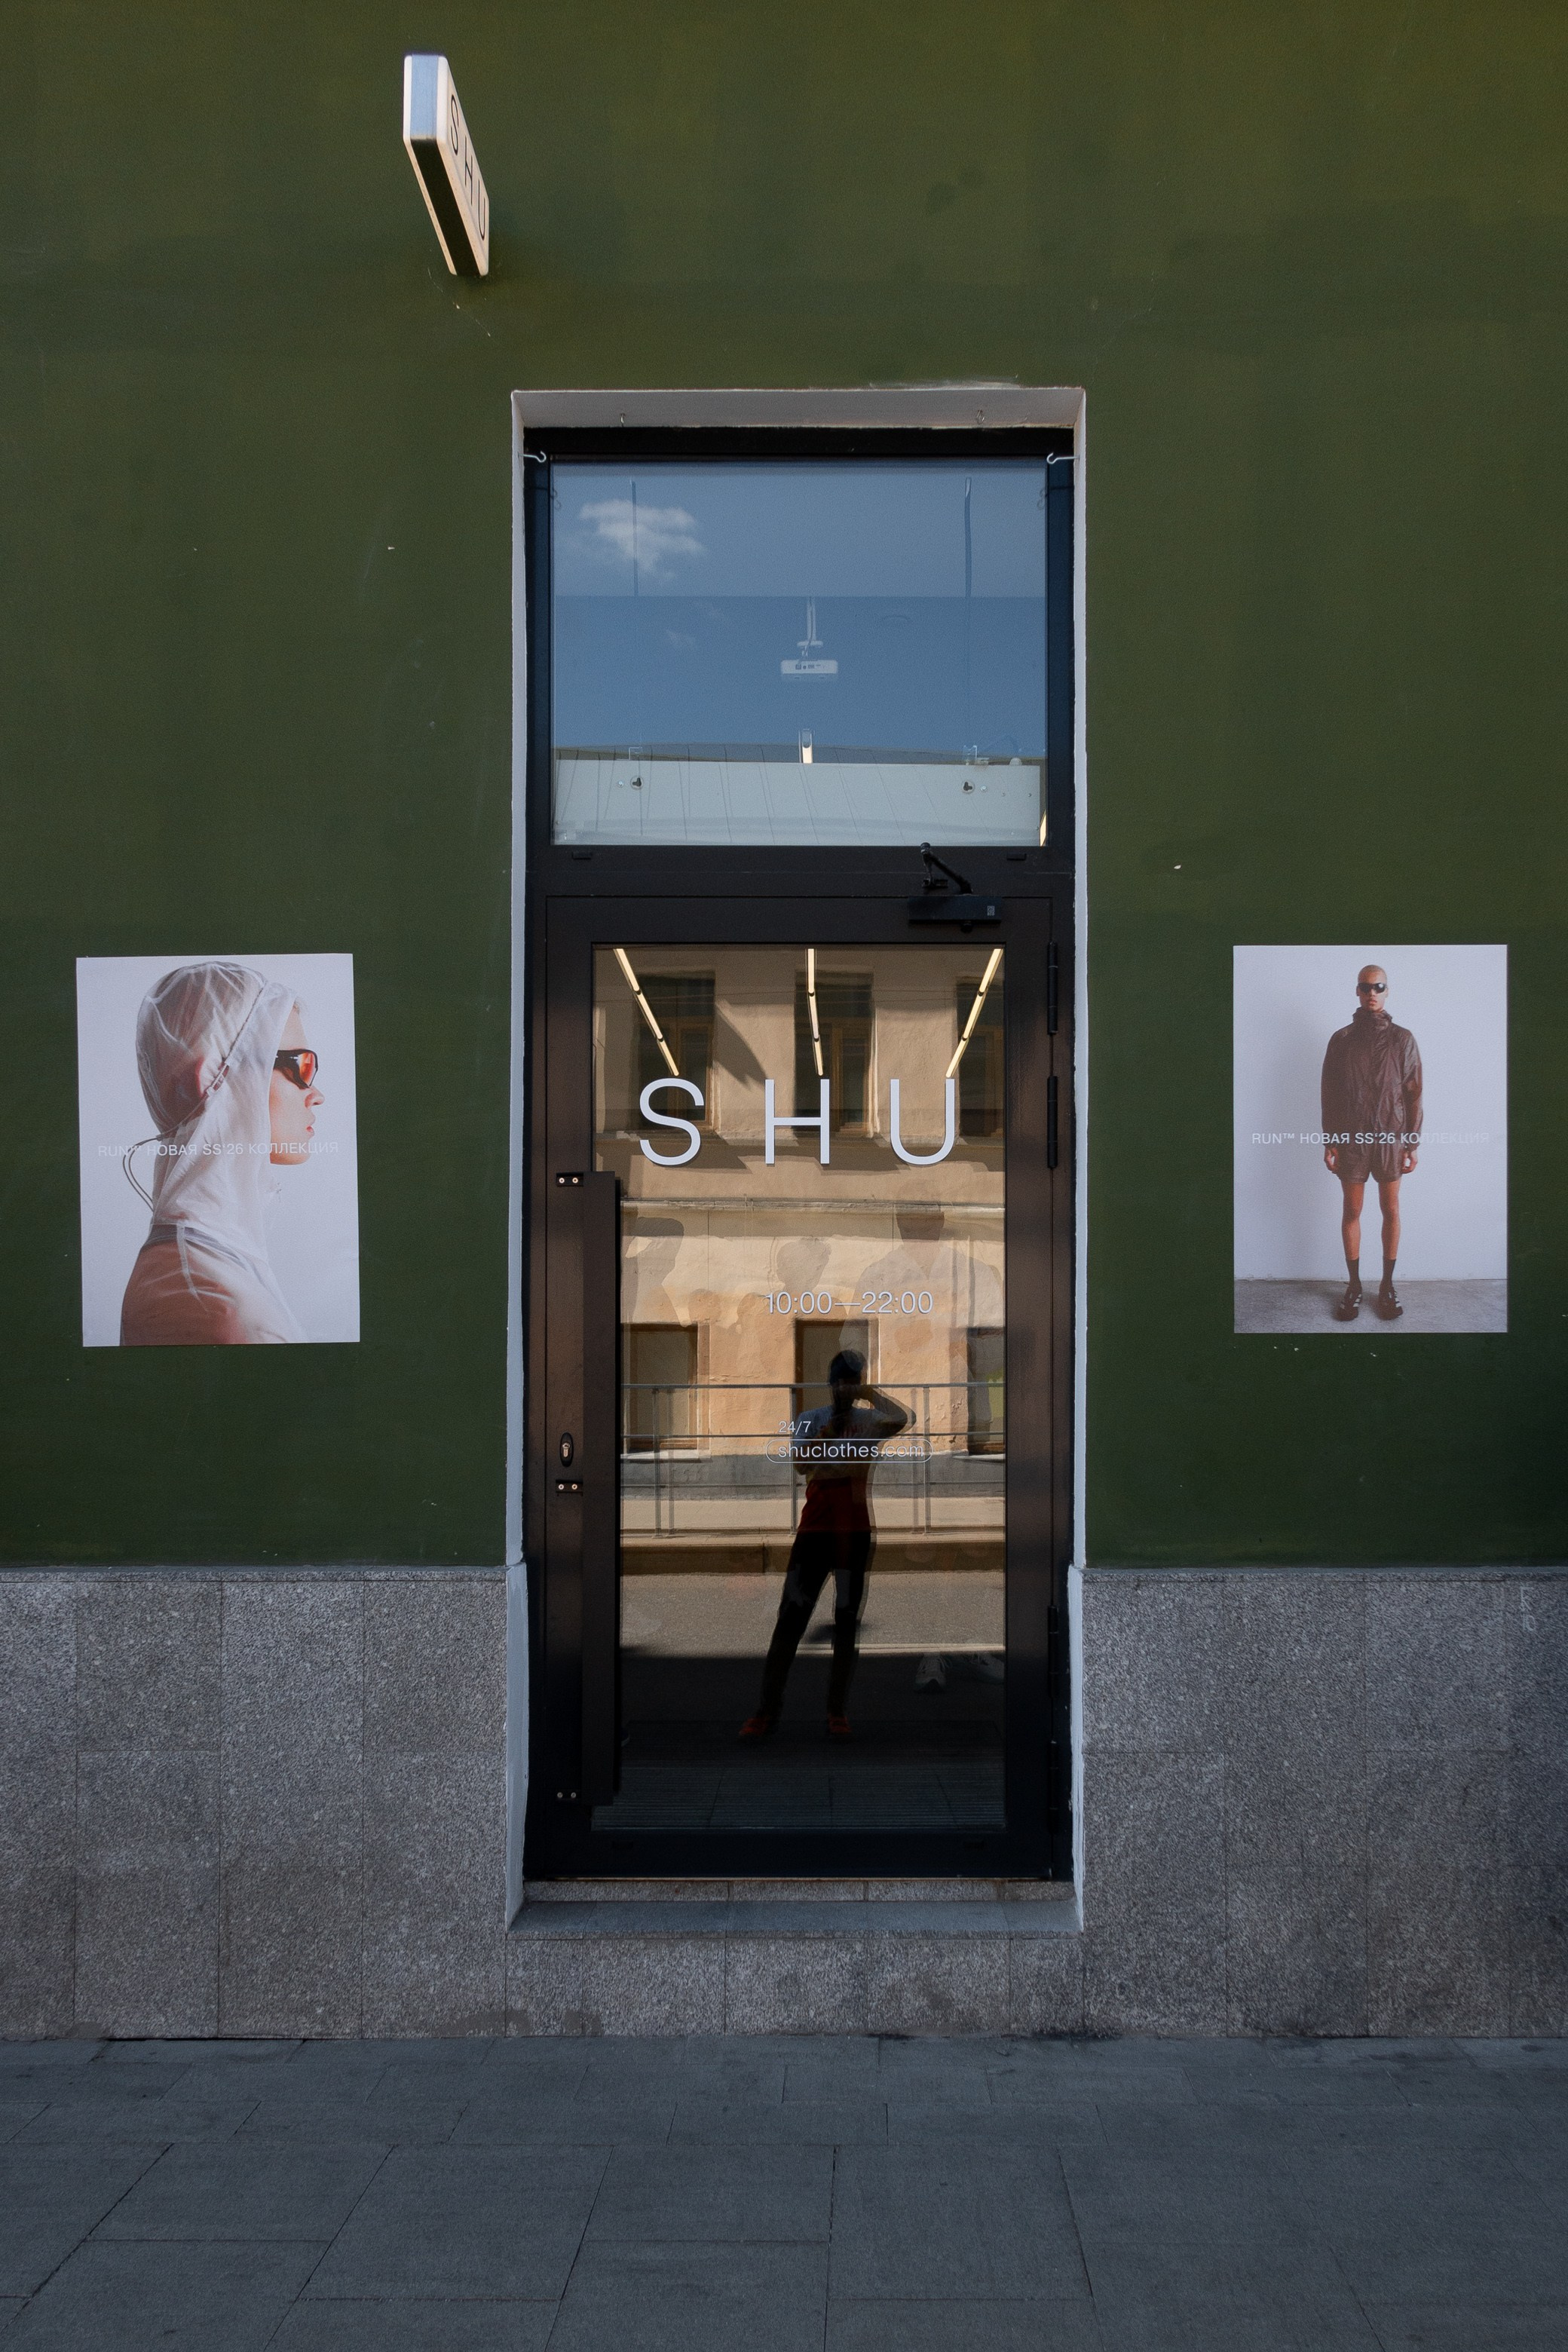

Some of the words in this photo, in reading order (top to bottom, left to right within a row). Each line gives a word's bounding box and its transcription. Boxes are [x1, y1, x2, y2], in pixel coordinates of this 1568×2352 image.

[450, 93, 486, 241] SHU
[639, 1077, 955, 1166] SHU
[1299, 1132, 1350, 1144] НОВАЯ
[1400, 1132, 1490, 1146] КОЛЛЕКЦИЯ
[146, 1144, 198, 1156] НОВАЯ
[248, 1141, 338, 1155] КОЛЛЕКЦИЯ
[778, 1420, 812, 1435] 24/7
[777, 1442, 924, 1458] shuclothes.com
